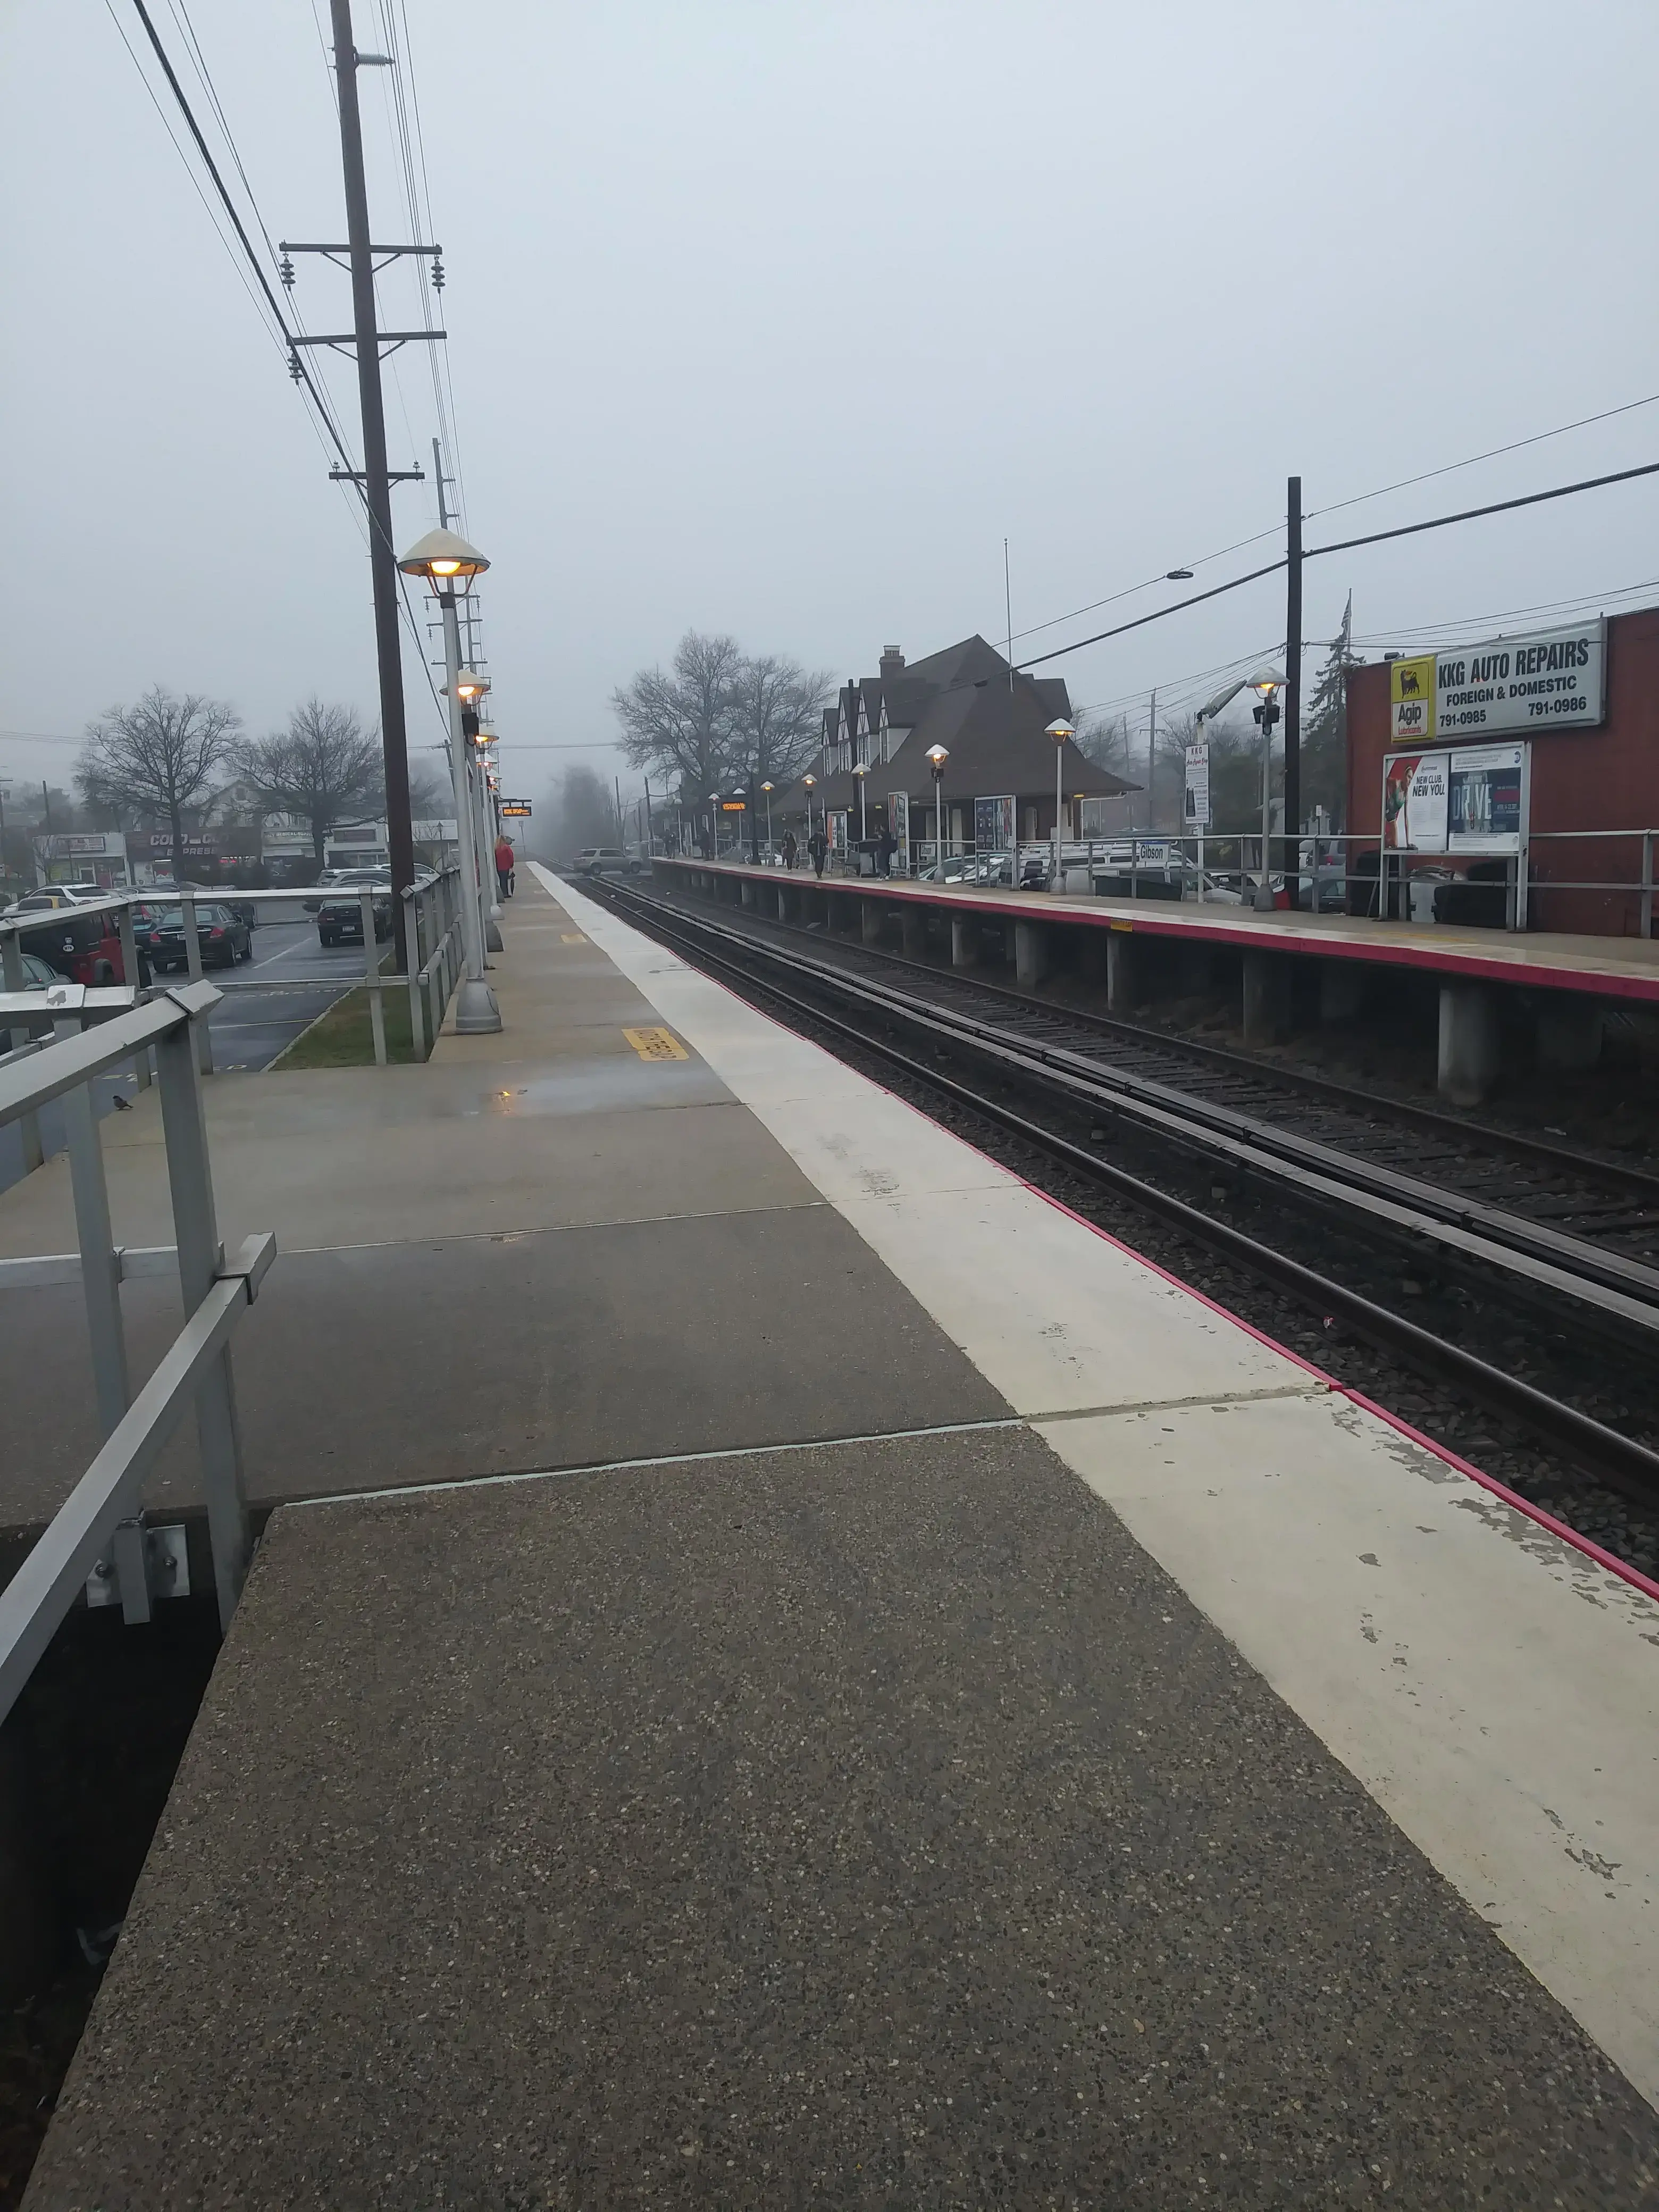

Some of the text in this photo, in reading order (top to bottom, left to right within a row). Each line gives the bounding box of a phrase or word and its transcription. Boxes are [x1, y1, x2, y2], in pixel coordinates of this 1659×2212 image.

[1438, 638, 1589, 689] KKG AUTO REPAIRS
[1446, 675, 1577, 707] FOREIGN & DOMESTIC
[1398, 702, 1421, 725] Agip
[1528, 696, 1587, 717] 791-0986
[1439, 709, 1486, 727] 791-0985
[1191, 747, 1202, 755] KKG
[1417, 774, 1443, 784] NEW CLUB.
[1412, 784, 1445, 797] NEW YOU.
[166, 847, 217, 856] EPRESS
[1140, 845, 1163, 859] Gibson
